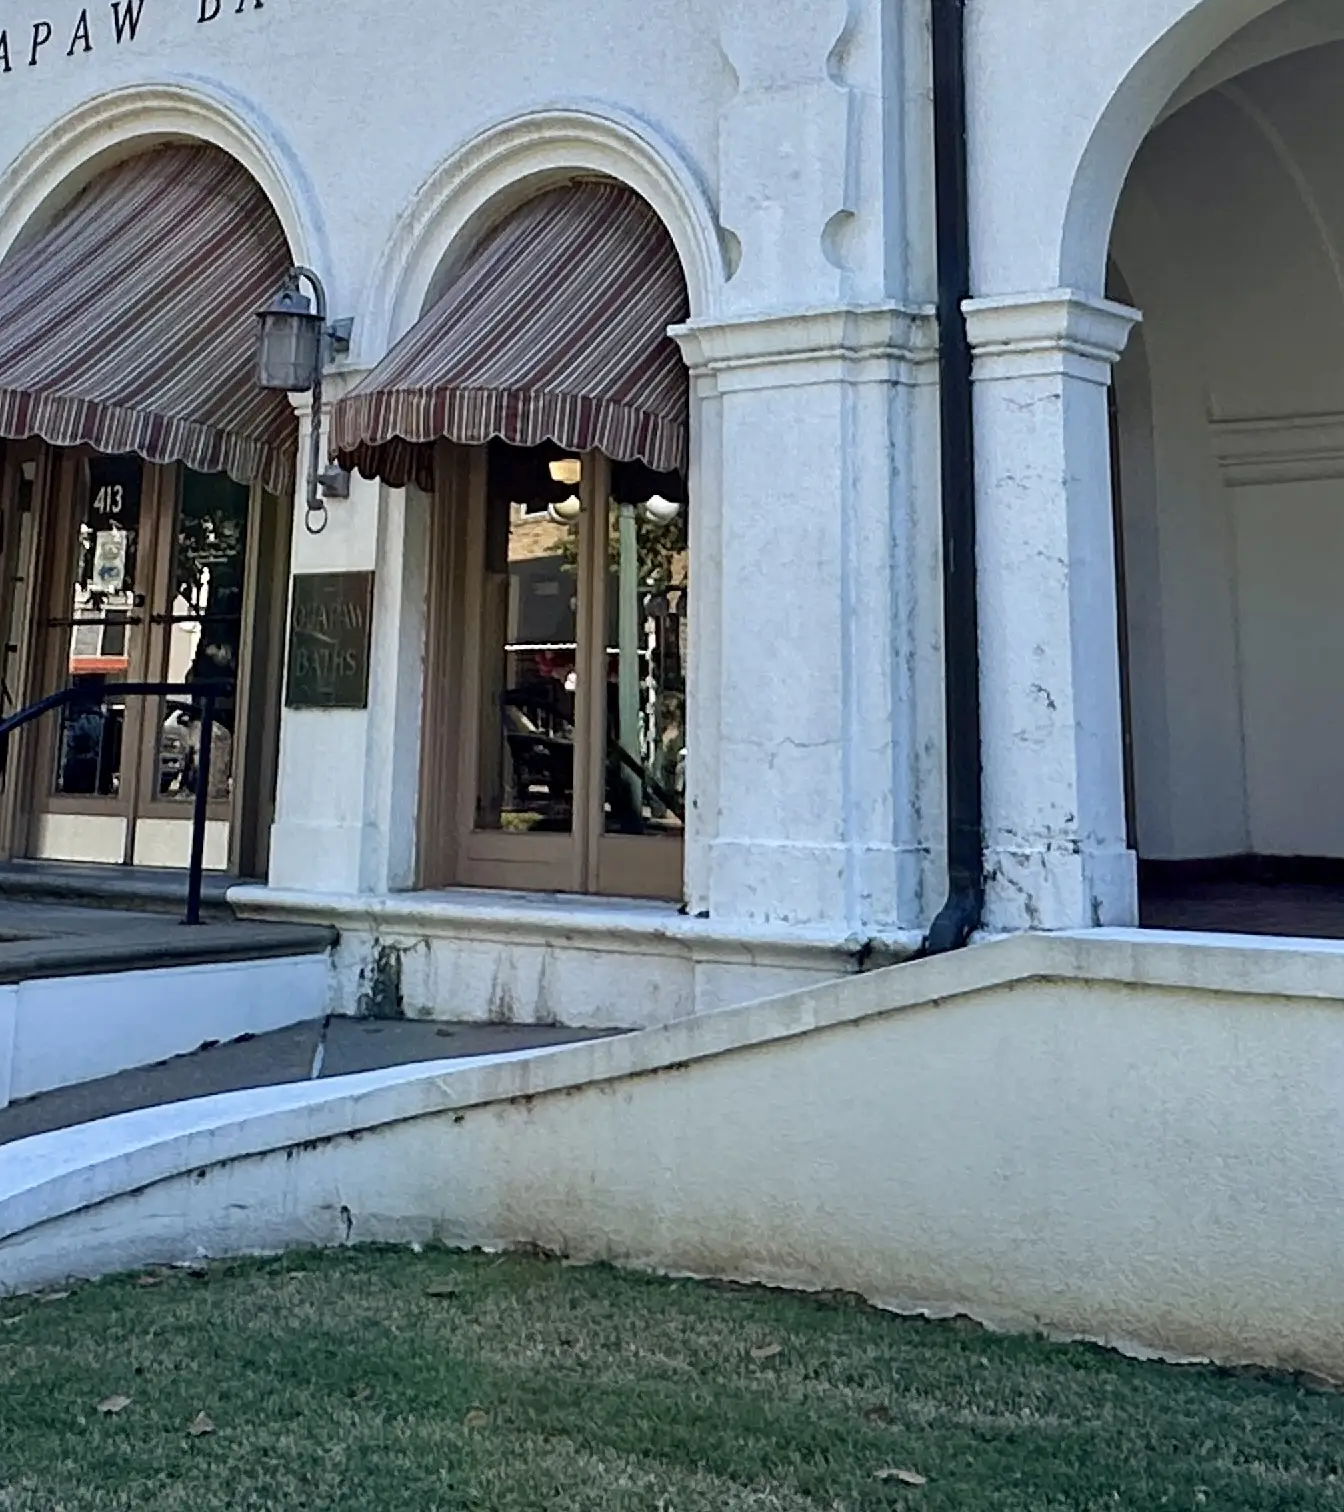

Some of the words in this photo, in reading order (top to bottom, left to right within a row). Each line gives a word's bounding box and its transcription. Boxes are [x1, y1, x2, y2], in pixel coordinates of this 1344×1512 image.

[93, 483, 124, 515] 413
[293, 602, 363, 632] QUAPAW
[295, 648, 357, 677] BATHS
